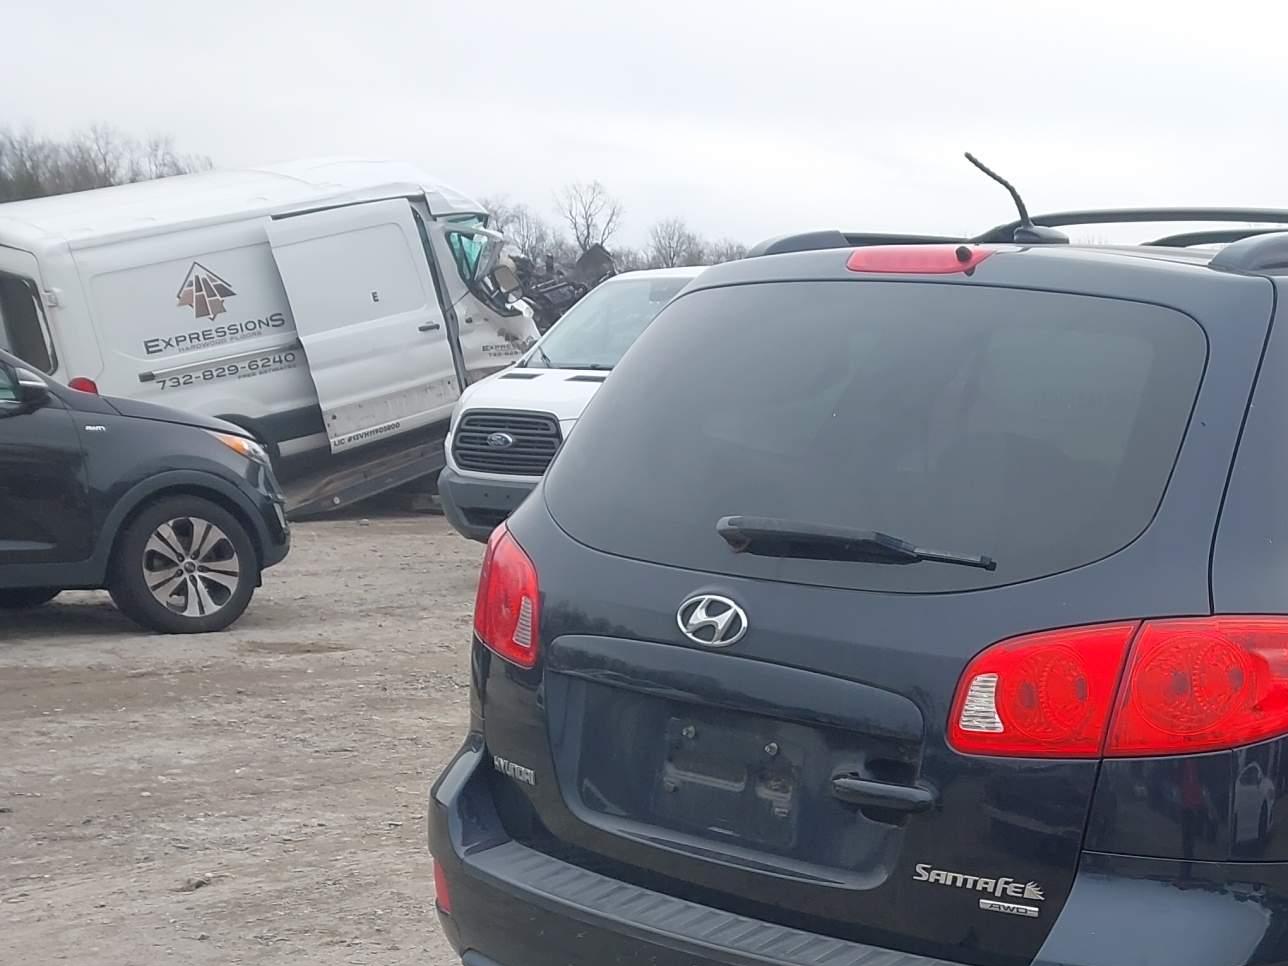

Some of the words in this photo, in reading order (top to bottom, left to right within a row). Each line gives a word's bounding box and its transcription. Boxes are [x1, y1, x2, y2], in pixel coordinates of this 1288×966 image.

[371, 291, 380, 303] E
[143, 312, 286, 355] EXPRESSIONS
[156, 352, 297, 390] 732-829-6240
[988, 902, 1029, 914] AWD
